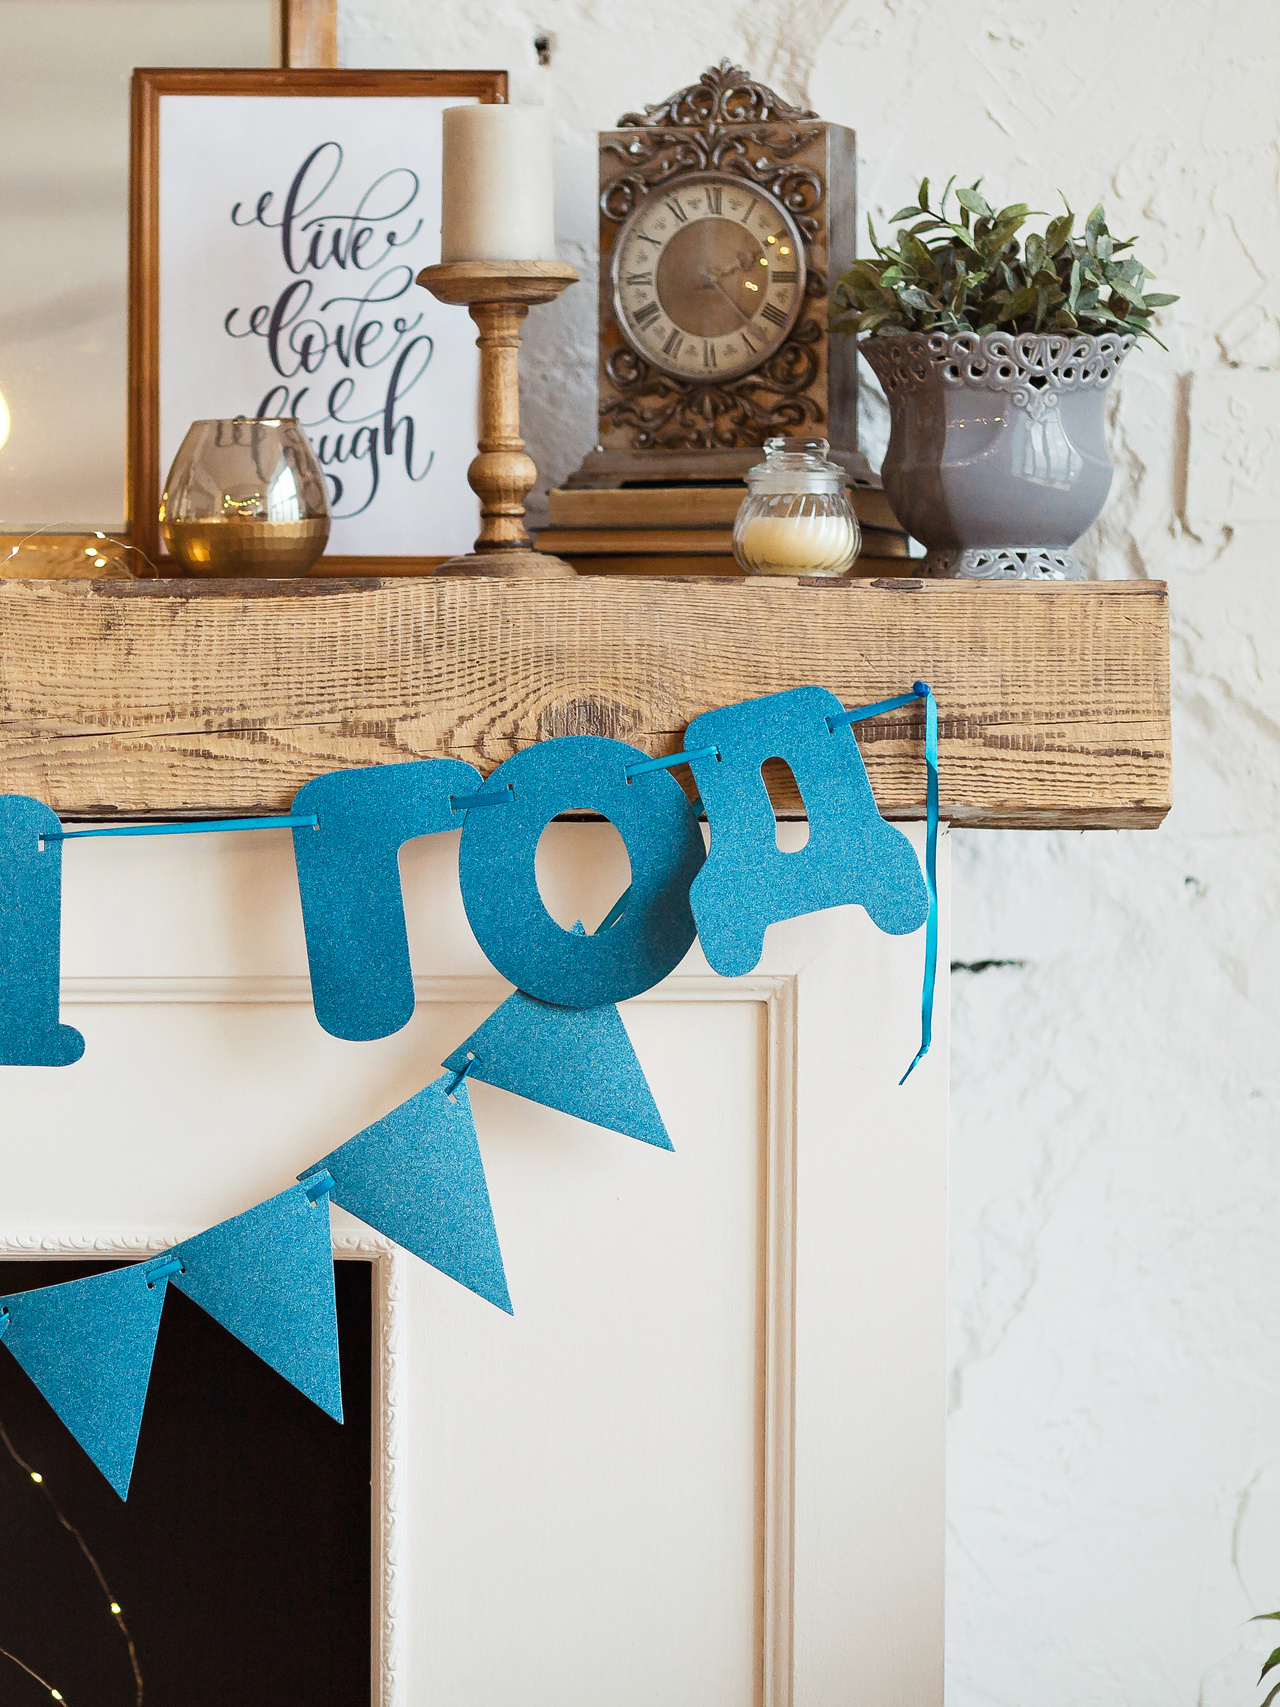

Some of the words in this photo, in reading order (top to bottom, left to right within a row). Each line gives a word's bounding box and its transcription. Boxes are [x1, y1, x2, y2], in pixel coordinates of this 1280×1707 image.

[231, 141, 424, 274] live
[224, 265, 424, 378] love
[291, 685, 928, 1042] ГОД
